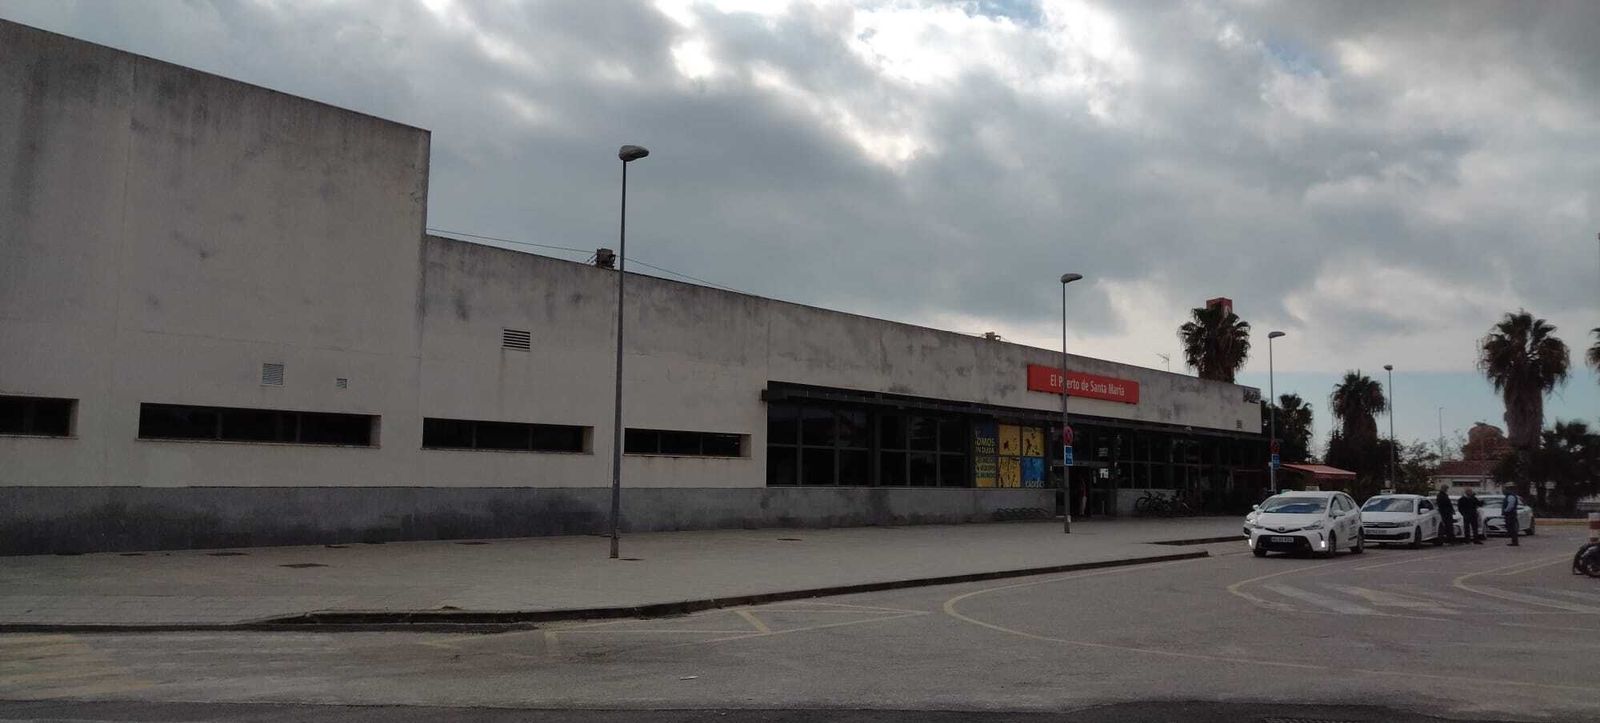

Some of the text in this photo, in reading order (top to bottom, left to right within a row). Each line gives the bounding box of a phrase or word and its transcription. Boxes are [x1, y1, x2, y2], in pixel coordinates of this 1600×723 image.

[1050, 374, 1057, 387] El
[1058, 376, 1080, 390] Perto
[1081, 379, 1089, 391] de
[1090, 381, 1107, 394] Santa
